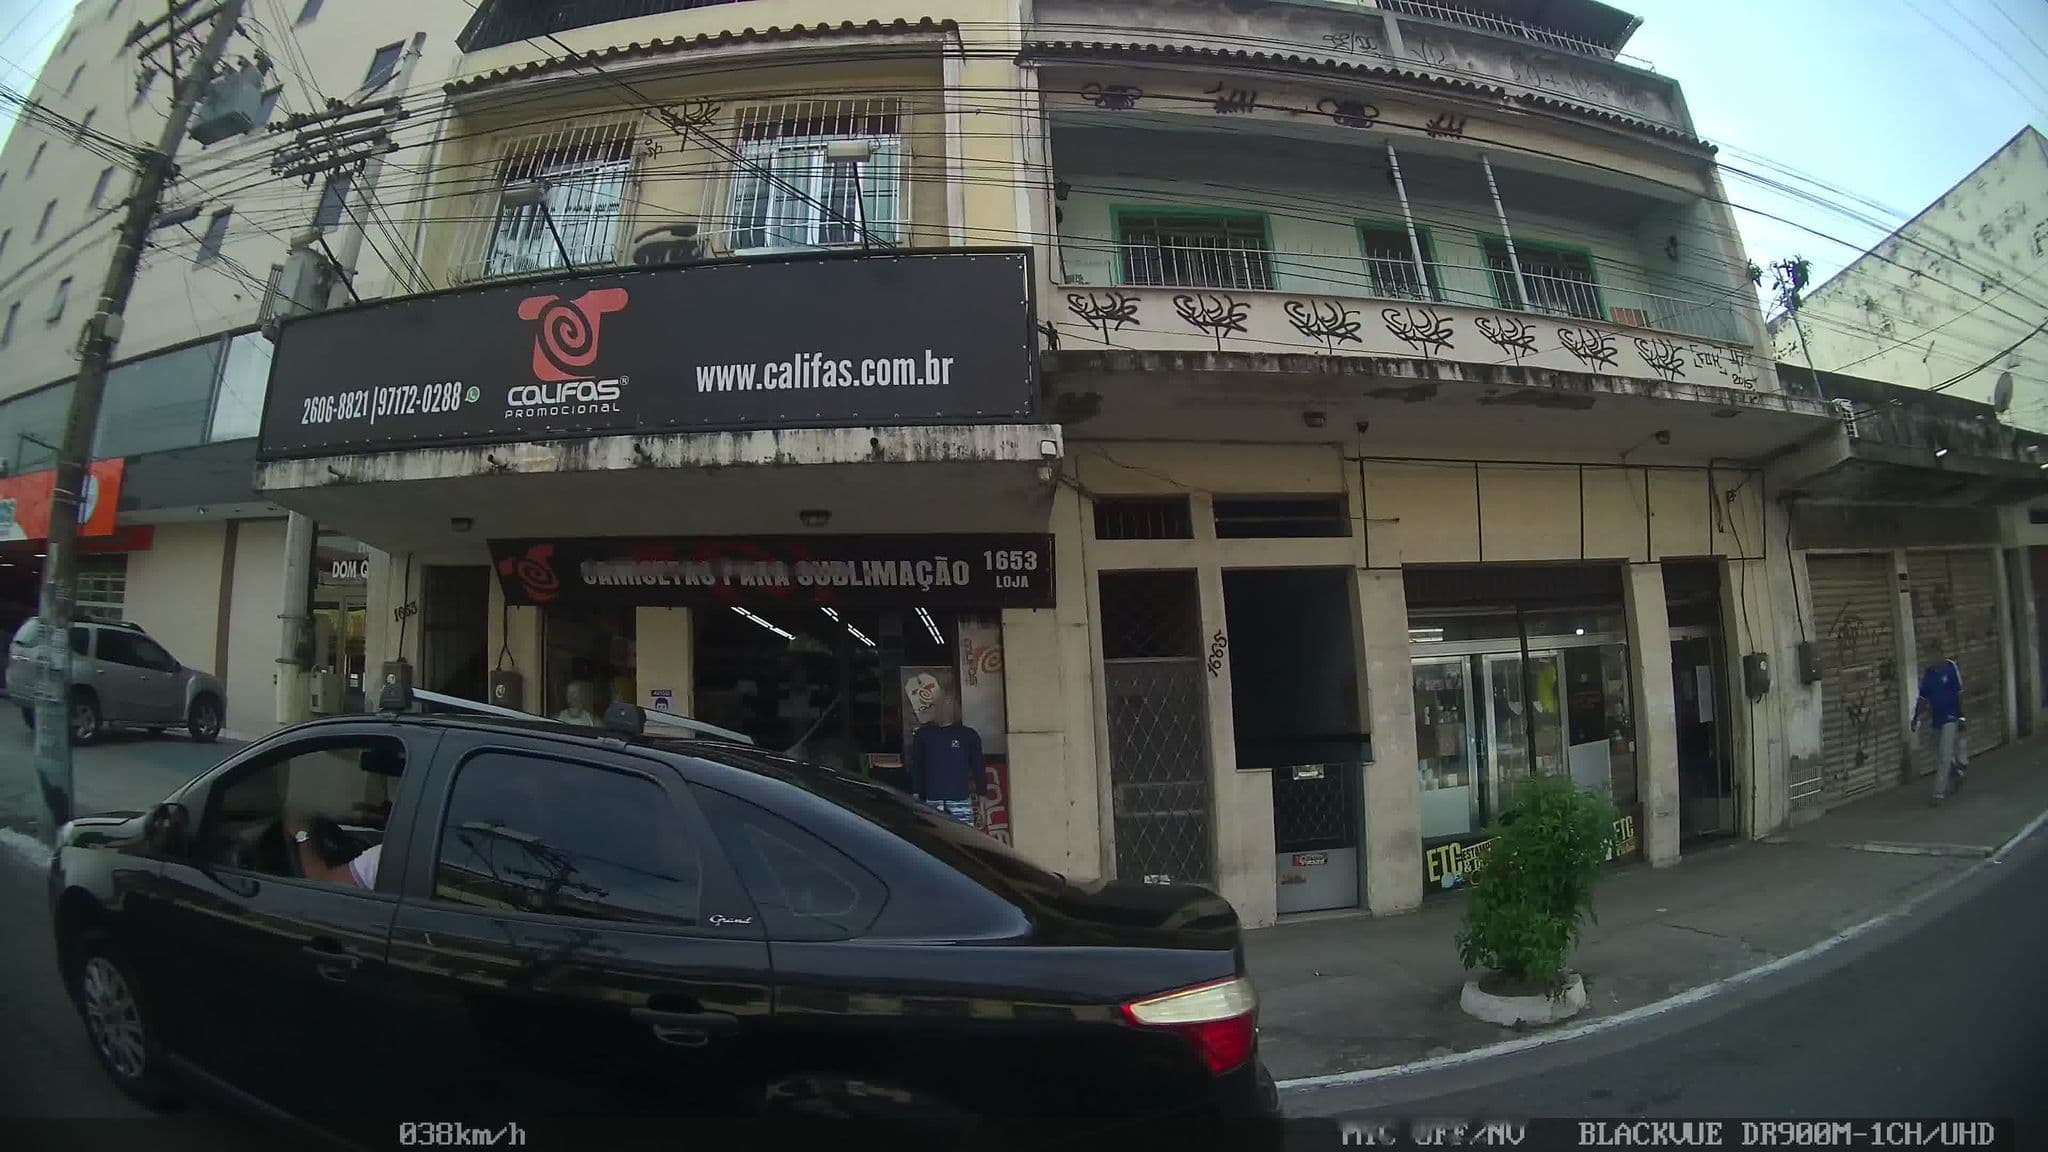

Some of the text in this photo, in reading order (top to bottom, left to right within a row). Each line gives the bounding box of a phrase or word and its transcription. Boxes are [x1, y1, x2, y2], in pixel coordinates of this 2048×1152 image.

[696, 350, 954, 392] www.califas.com.br
[504, 402, 621, 419] PROMOCIONAL
[332, 560, 357, 578] DOM
[983, 550, 1038, 571] 1653
[996, 575, 1030, 588] LOJA
[1207, 629, 1227, 678] 1665
[1426, 842, 1463, 883] ETC
